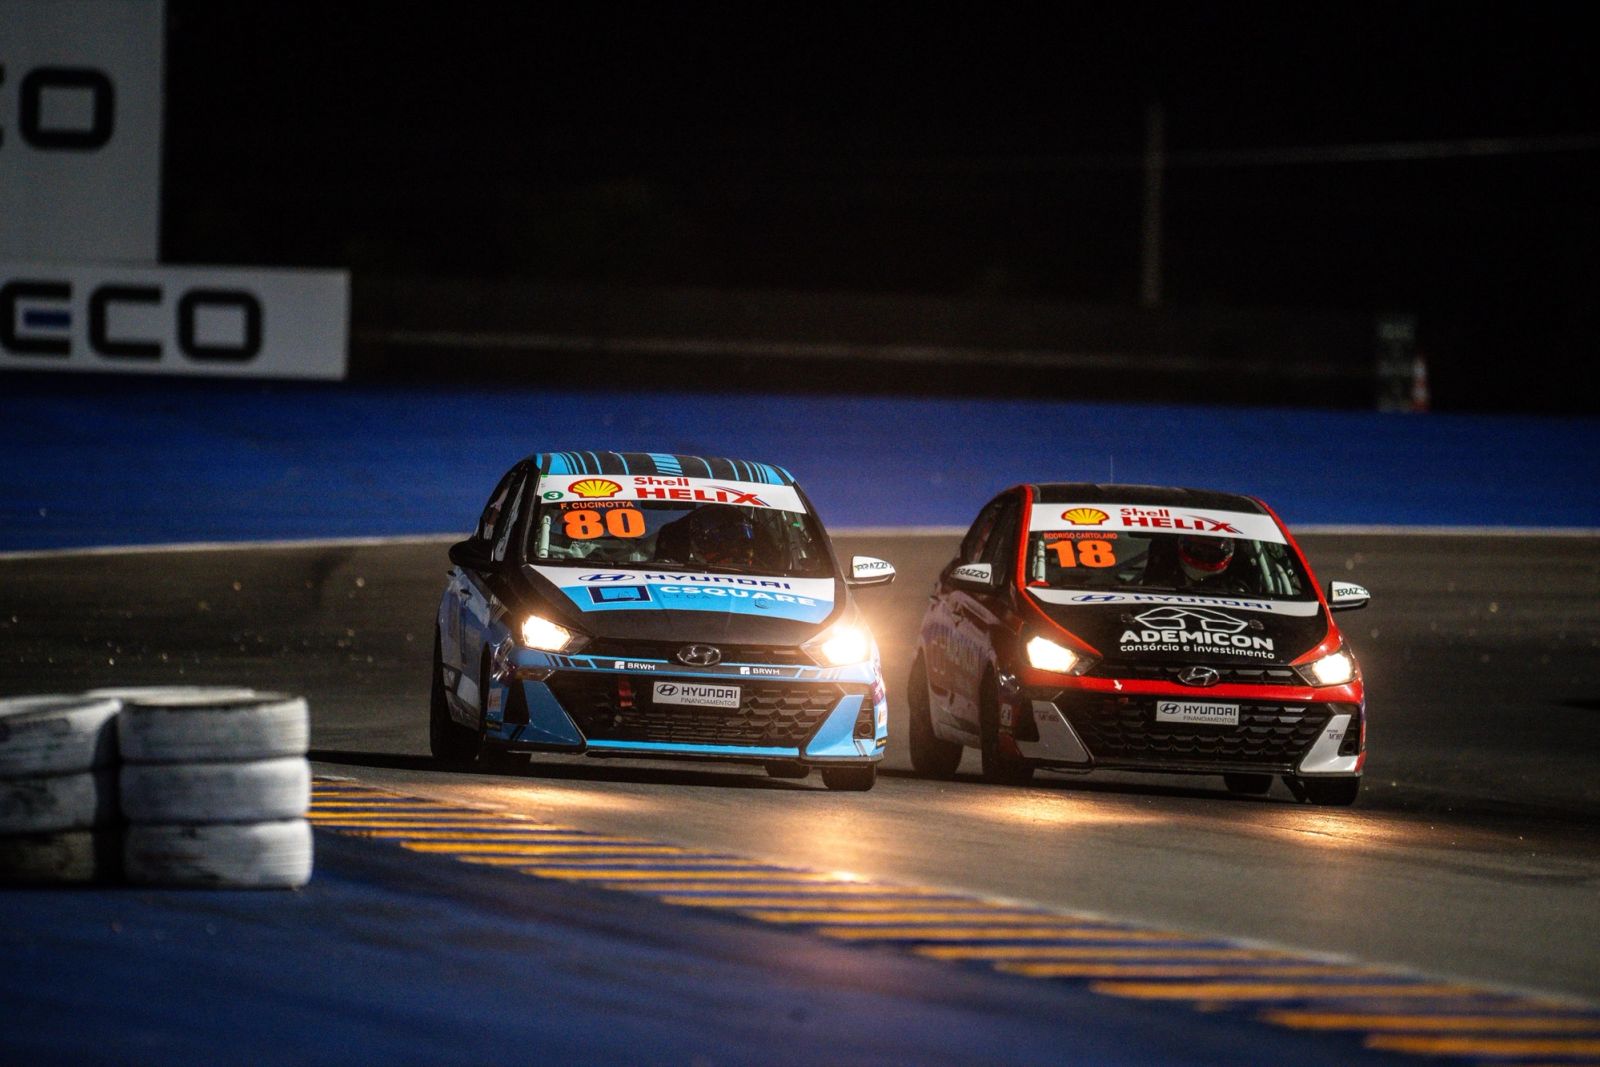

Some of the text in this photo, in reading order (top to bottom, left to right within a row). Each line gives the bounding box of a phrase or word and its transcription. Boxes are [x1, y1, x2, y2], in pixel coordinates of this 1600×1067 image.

[0, 65, 115, 152] O
[634, 476, 689, 487] Shell
[634, 487, 766, 507] HELIX
[560, 501, 634, 510] F. CUCINOTTA
[1120, 508, 1170, 518] Shell
[563, 507, 646, 540] 80
[1121, 516, 1239, 535] HELIX
[1045, 539, 1116, 568] 18
[644, 573, 791, 590] HYUNDAI
[659, 586, 817, 607] CSQUARE
[1133, 595, 1273, 610] HYUNDAI
[1119, 630, 1275, 651] ADEMICON
[1120, 641, 1180, 652] consórcio
[1193, 643, 1275, 660] investimento
[627, 662, 656, 671] BRWM
[752, 668, 780, 676] BRWM
[681, 686, 737, 699] HYUNDAI
[680, 697, 737, 707] FINANCIAMENTOS
[1183, 705, 1237, 717] HYUNDAI
[1182, 715, 1236, 725] FINANCIAMENTOS
